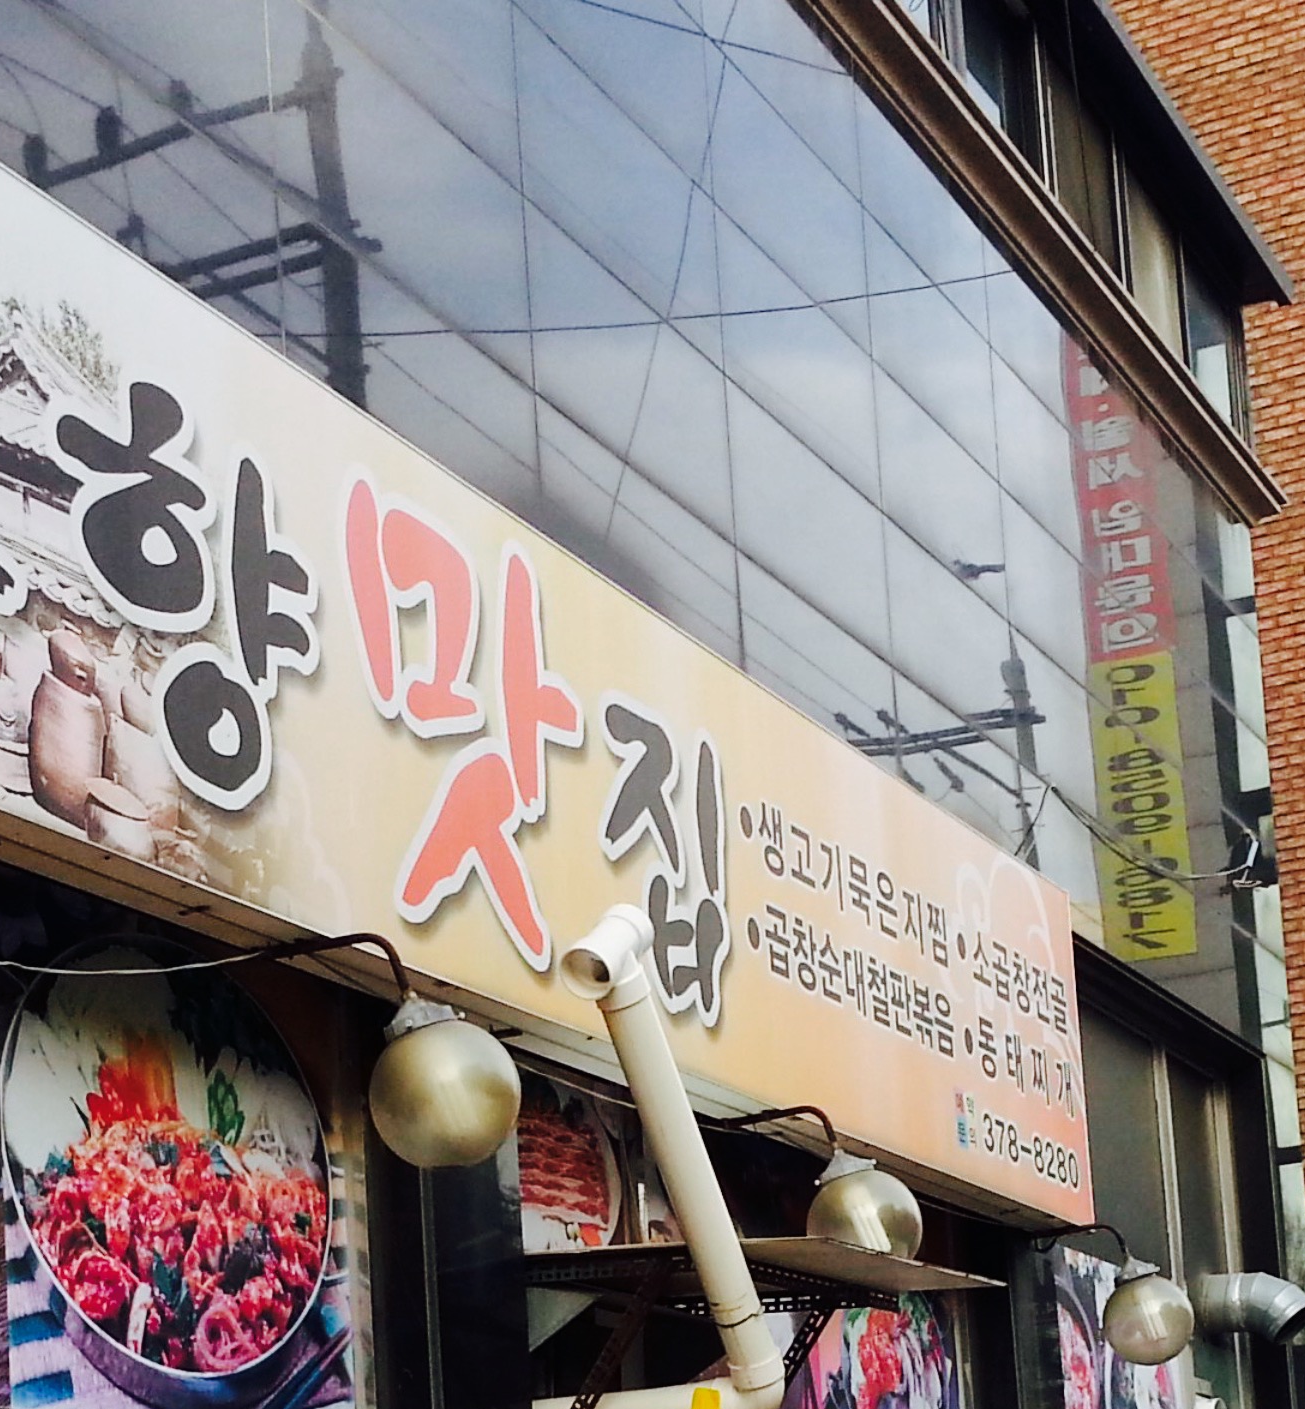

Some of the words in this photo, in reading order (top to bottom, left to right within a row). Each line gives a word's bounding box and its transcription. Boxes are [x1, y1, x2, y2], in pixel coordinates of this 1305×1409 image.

[758, 801, 949, 969] 생고기묵은지찜
[972, 930, 1069, 1035] 소곱창전골
[765, 903, 955, 1059] 곱창순대철판볶음
[983, 1113, 1079, 1189] 378-8280
